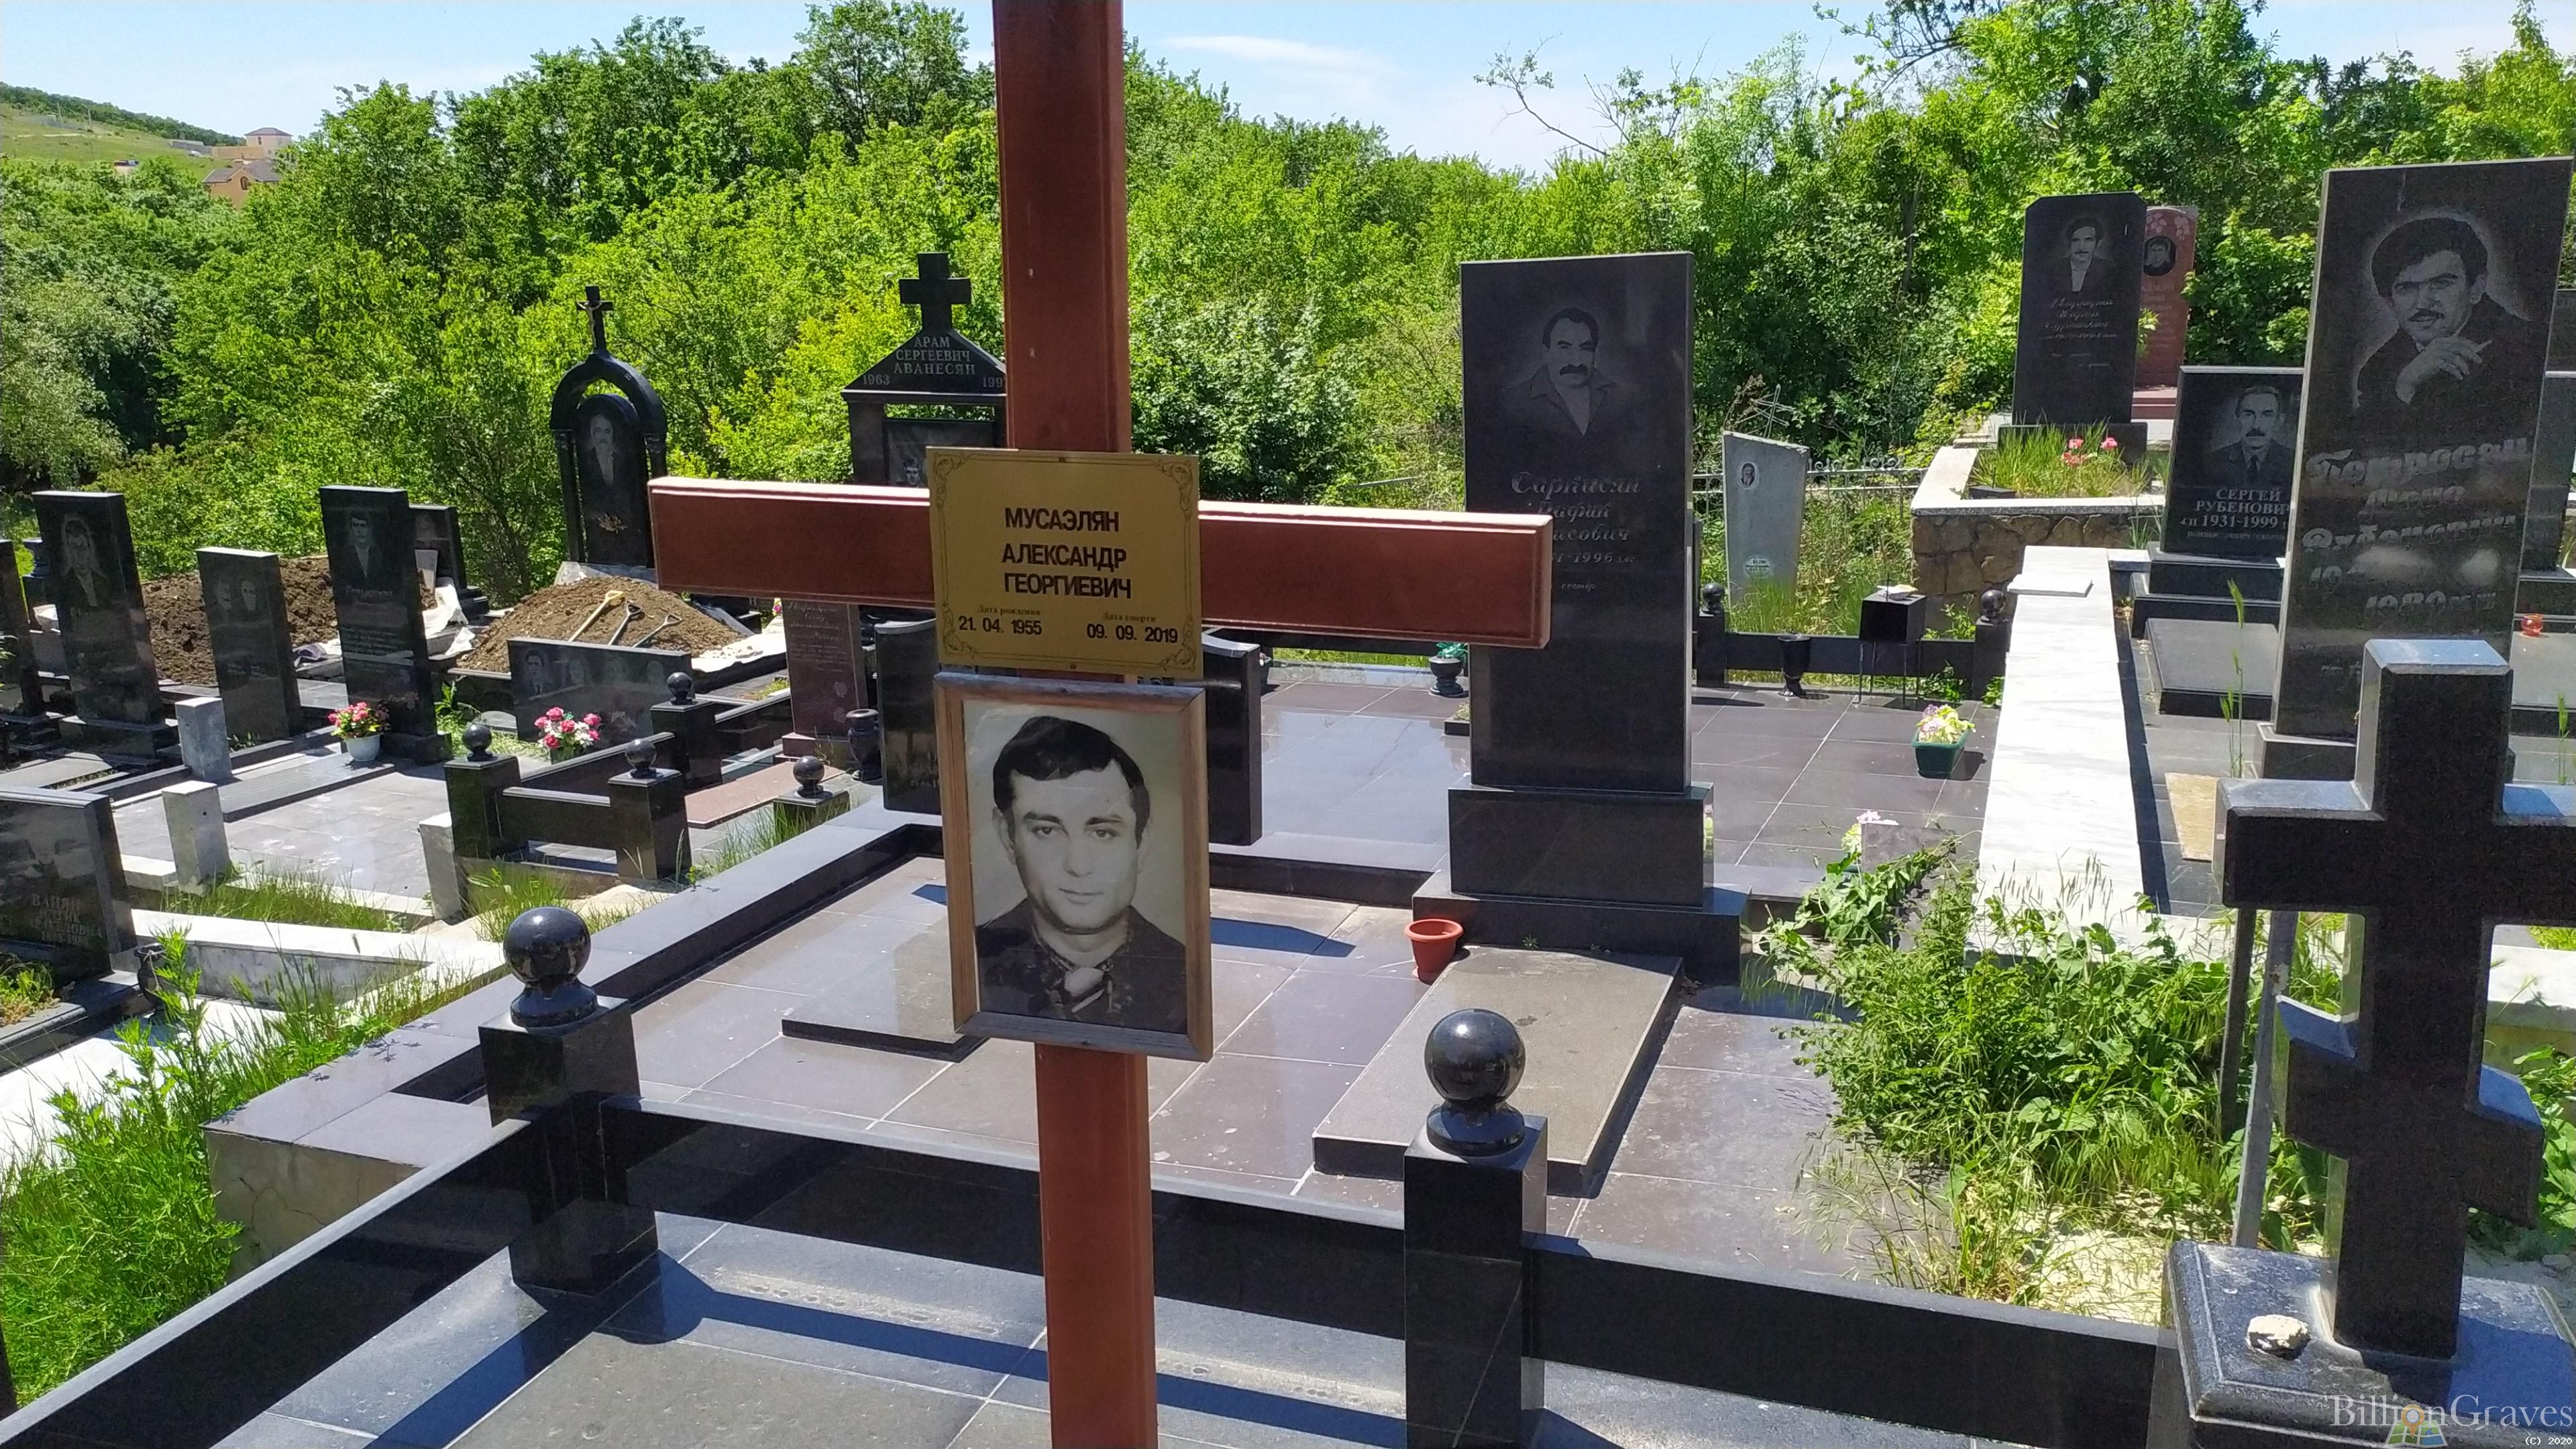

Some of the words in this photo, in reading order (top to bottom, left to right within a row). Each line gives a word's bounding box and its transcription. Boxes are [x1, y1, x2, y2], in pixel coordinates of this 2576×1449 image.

[914, 336, 951, 348] АРАМ
[896, 349, 971, 361] СЕРГЕЕВИЧ
[894, 363, 975, 374] АВАНЕСЯН
[863, 374, 891, 386] 1963
[1511, 471, 1642, 500] Саркисян
[2216, 488, 2281, 502] СЕРГЕЙ
[1004, 508, 1119, 532] МУСАЭЛЯН
[2202, 515, 2278, 528] 1931-1999
[1002, 543, 1127, 572] АЛЕКСАНДР
[1004, 573, 1132, 599] ГЕОРГИЕВИЧ
[978, 605, 998, 614] Дата
[1000, 607, 1041, 617] рождения
[1102, 612, 1122, 622] Дата
[1124, 614, 1157, 625] смерти
[959, 616, 977, 631] 21.
[982, 617, 1004, 633] 04.
[1011, 619, 1042, 635] 1955
[1087, 623, 1108, 639] 09.
[1116, 625, 1138, 641] 09.
[1144, 627, 1178, 643] 2019
